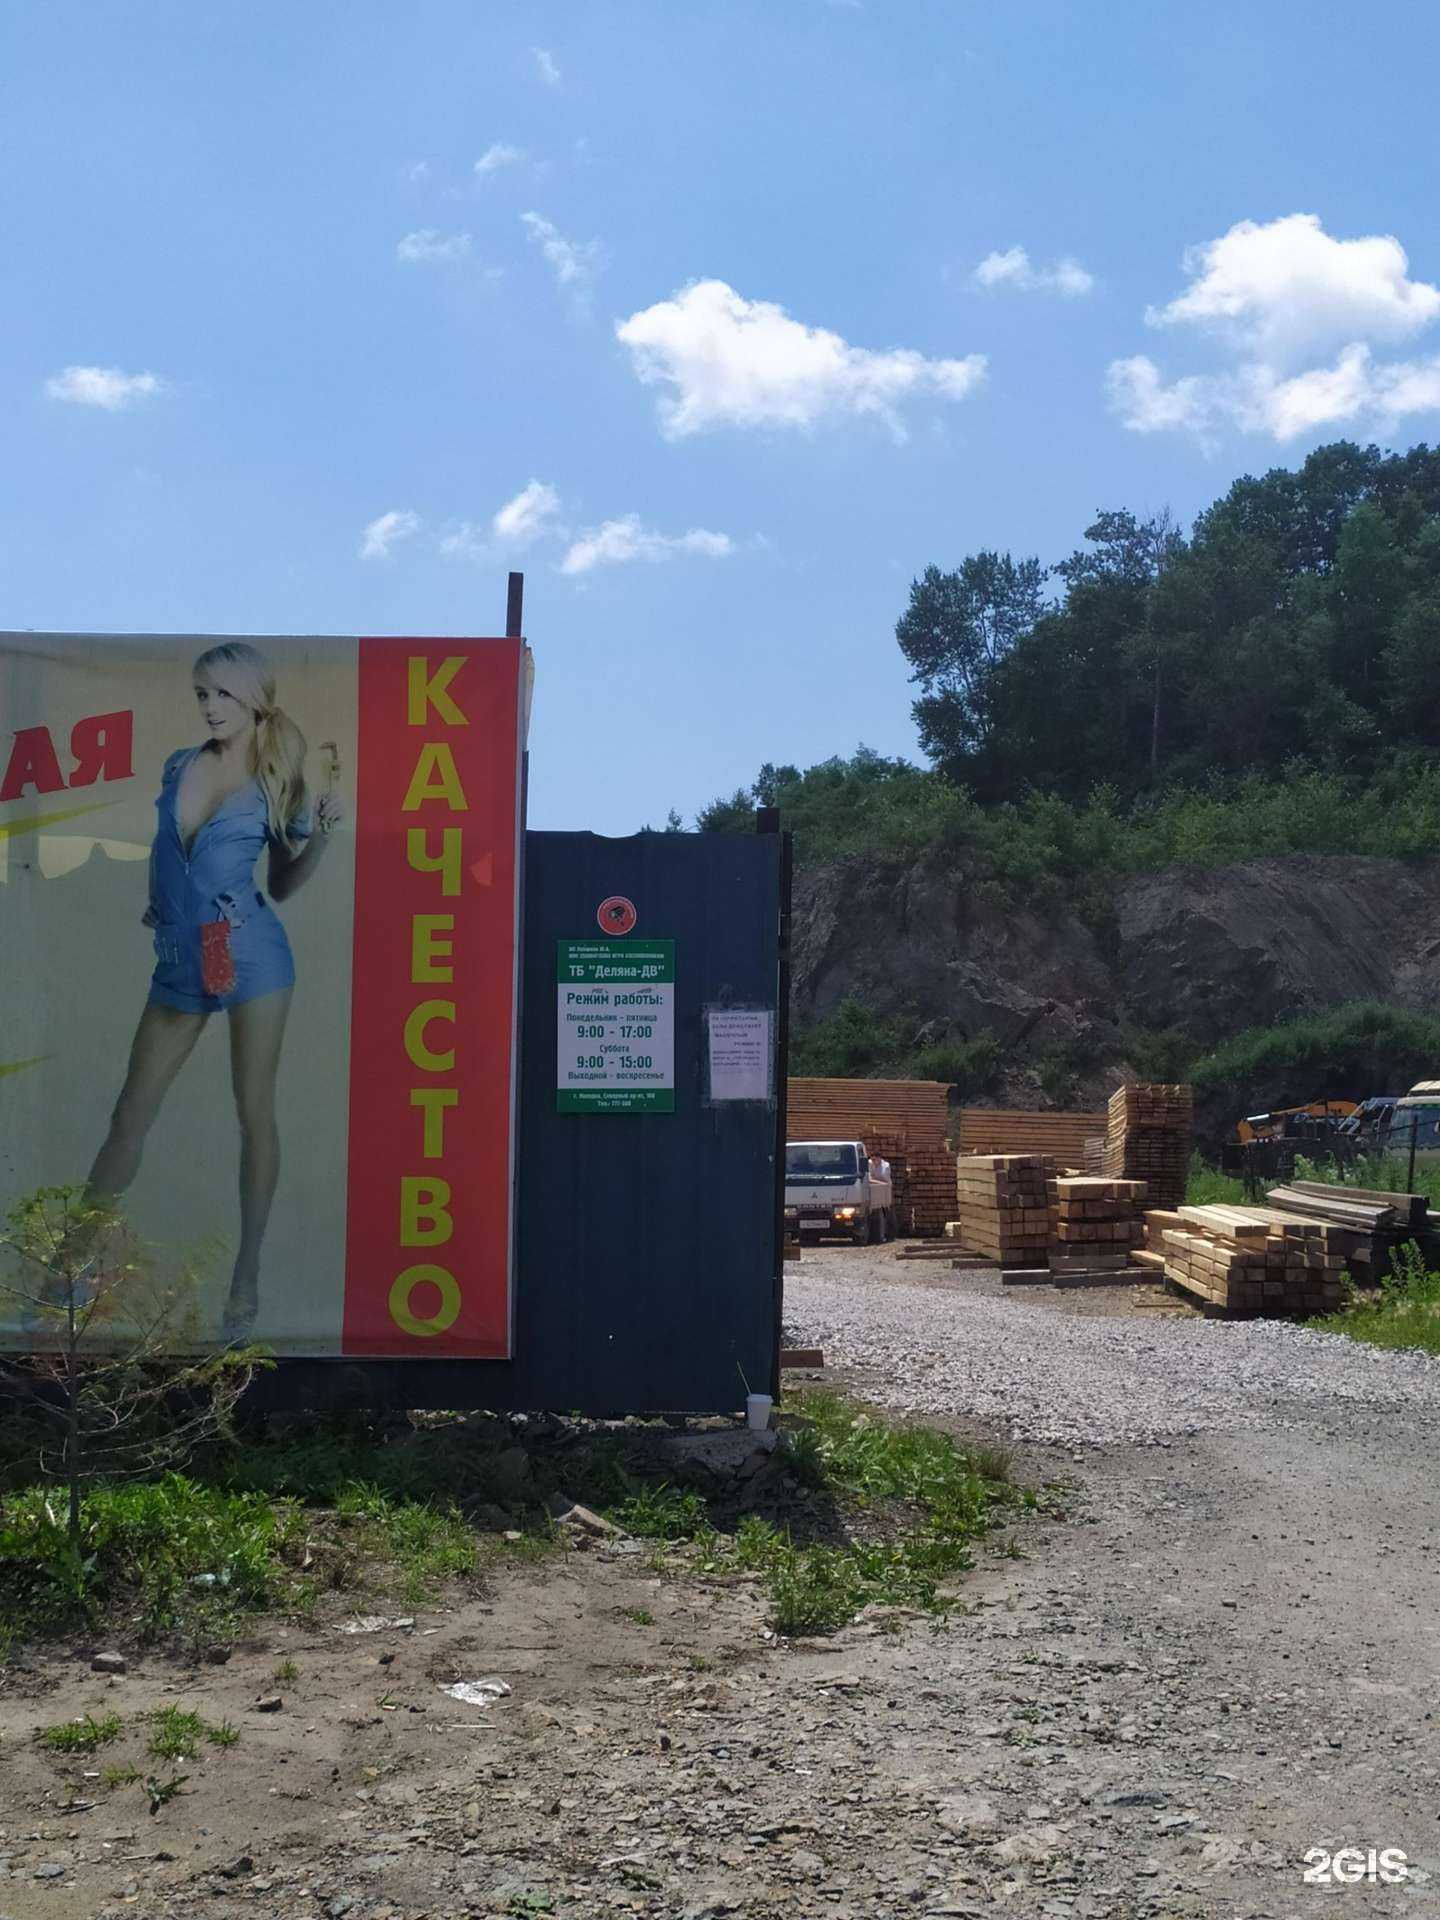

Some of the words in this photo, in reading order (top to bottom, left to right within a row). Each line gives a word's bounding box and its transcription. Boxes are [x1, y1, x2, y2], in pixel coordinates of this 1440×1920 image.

[0, 709, 134, 802] АЯ
[569, 965, 585, 977] ТБ
[388, 655, 469, 1338] КАЧЕСТВО
[566, 992, 609, 1005] Режим
[614, 993, 664, 1007] работы:
[566, 1013, 617, 1022] Понедельник
[577, 1025, 605, 1038] 9:00
[619, 1025, 652, 1038] 17:00
[599, 1044, 630, 1053] Суббота
[576, 1056, 604, 1068] 9:00
[619, 1056, 652, 1068] 15:00
[568, 1071, 608, 1081] Выходной
[616, 1072, 665, 1081] воскресенье
